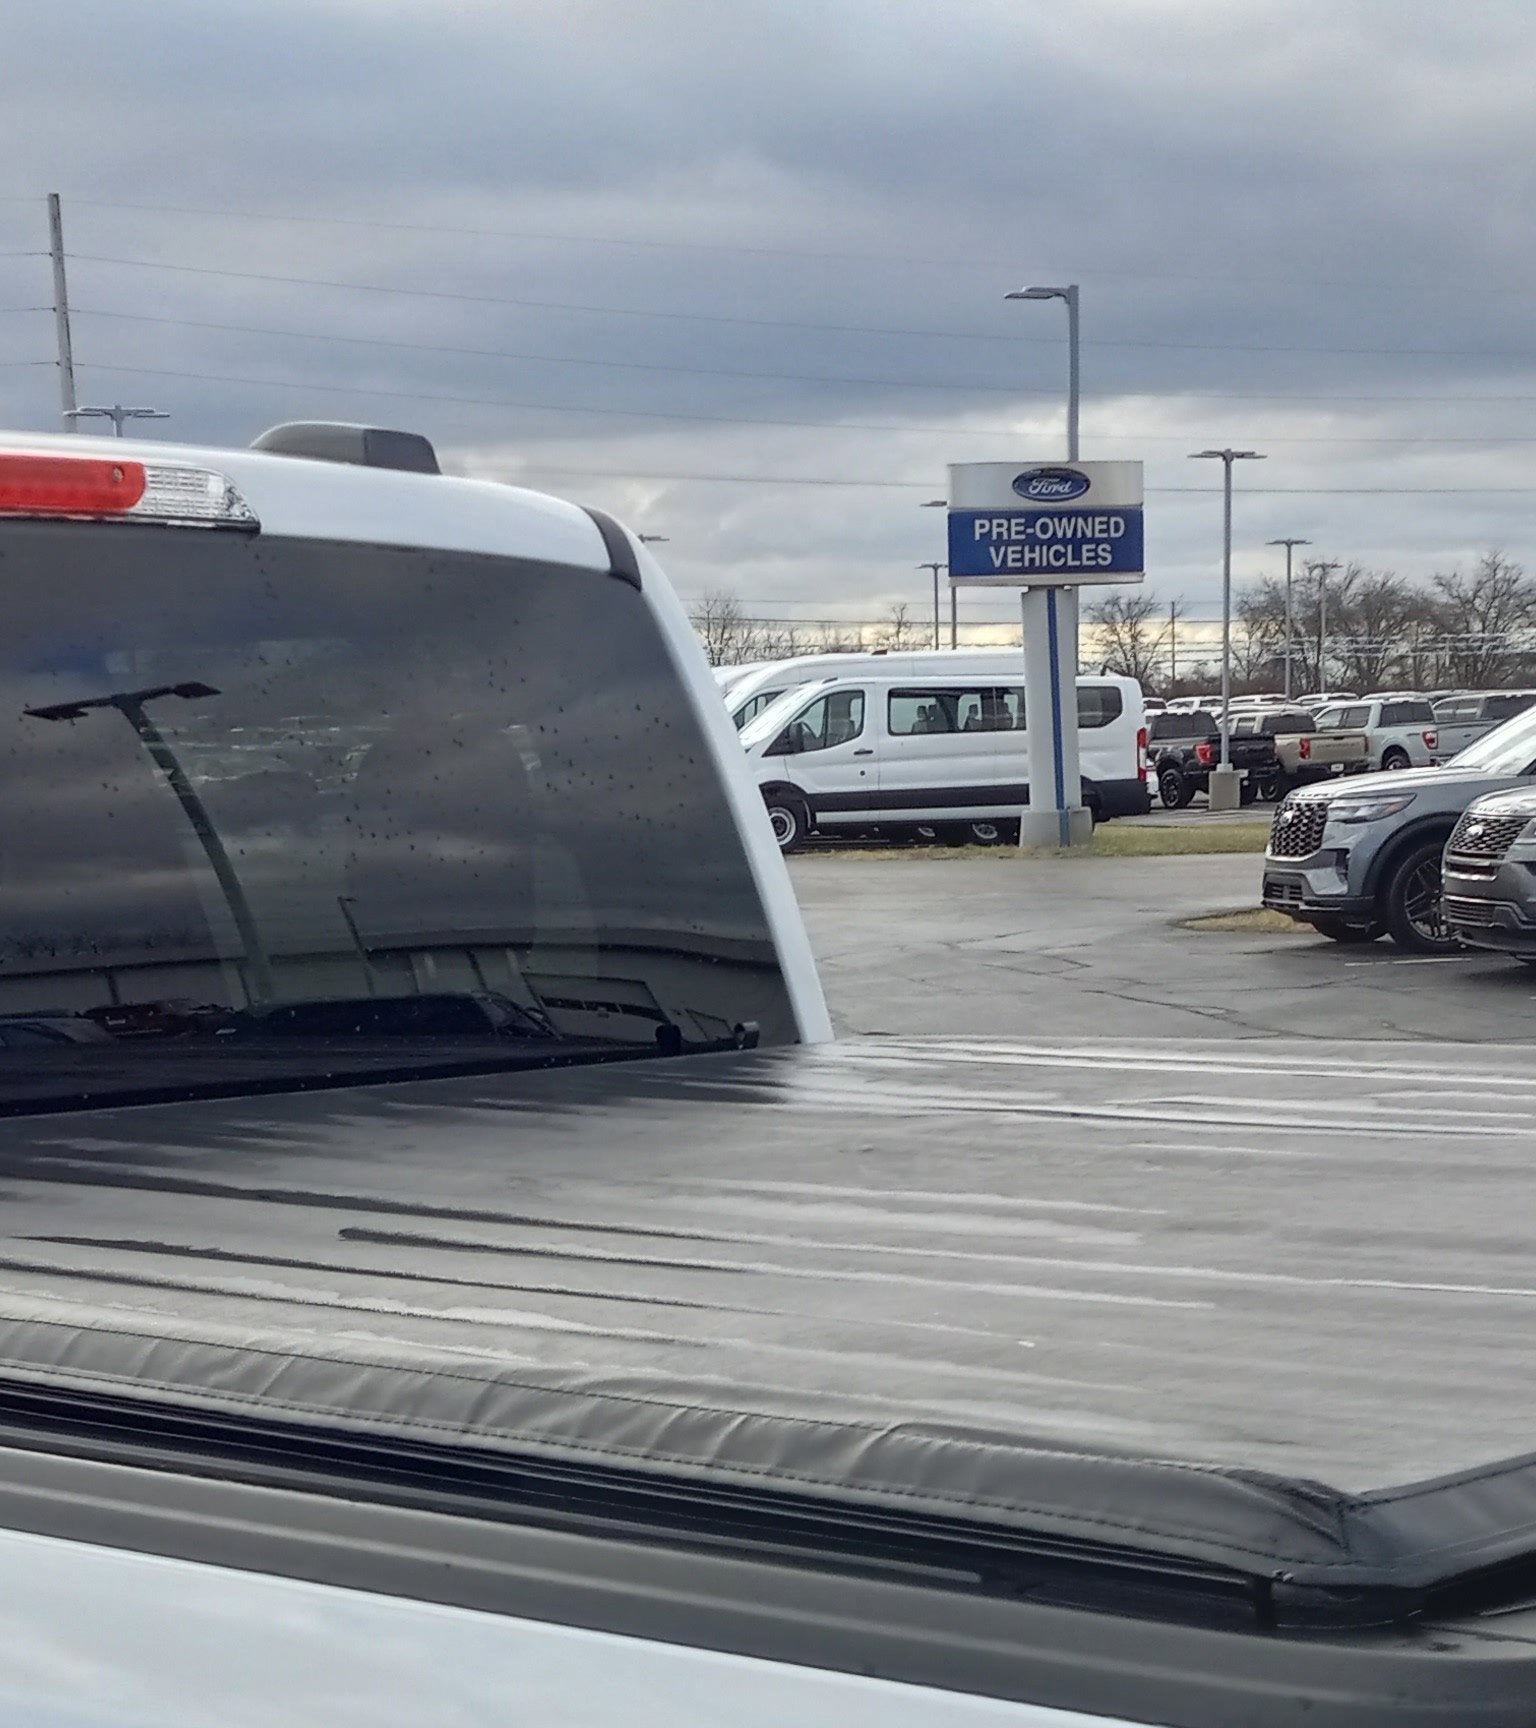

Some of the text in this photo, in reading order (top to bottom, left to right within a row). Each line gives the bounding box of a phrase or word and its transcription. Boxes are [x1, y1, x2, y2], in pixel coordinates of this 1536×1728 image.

[1028, 478, 1072, 494] Ford
[974, 516, 1125, 541] PRE-OWNED
[989, 543, 1113, 568] VEHICLES
